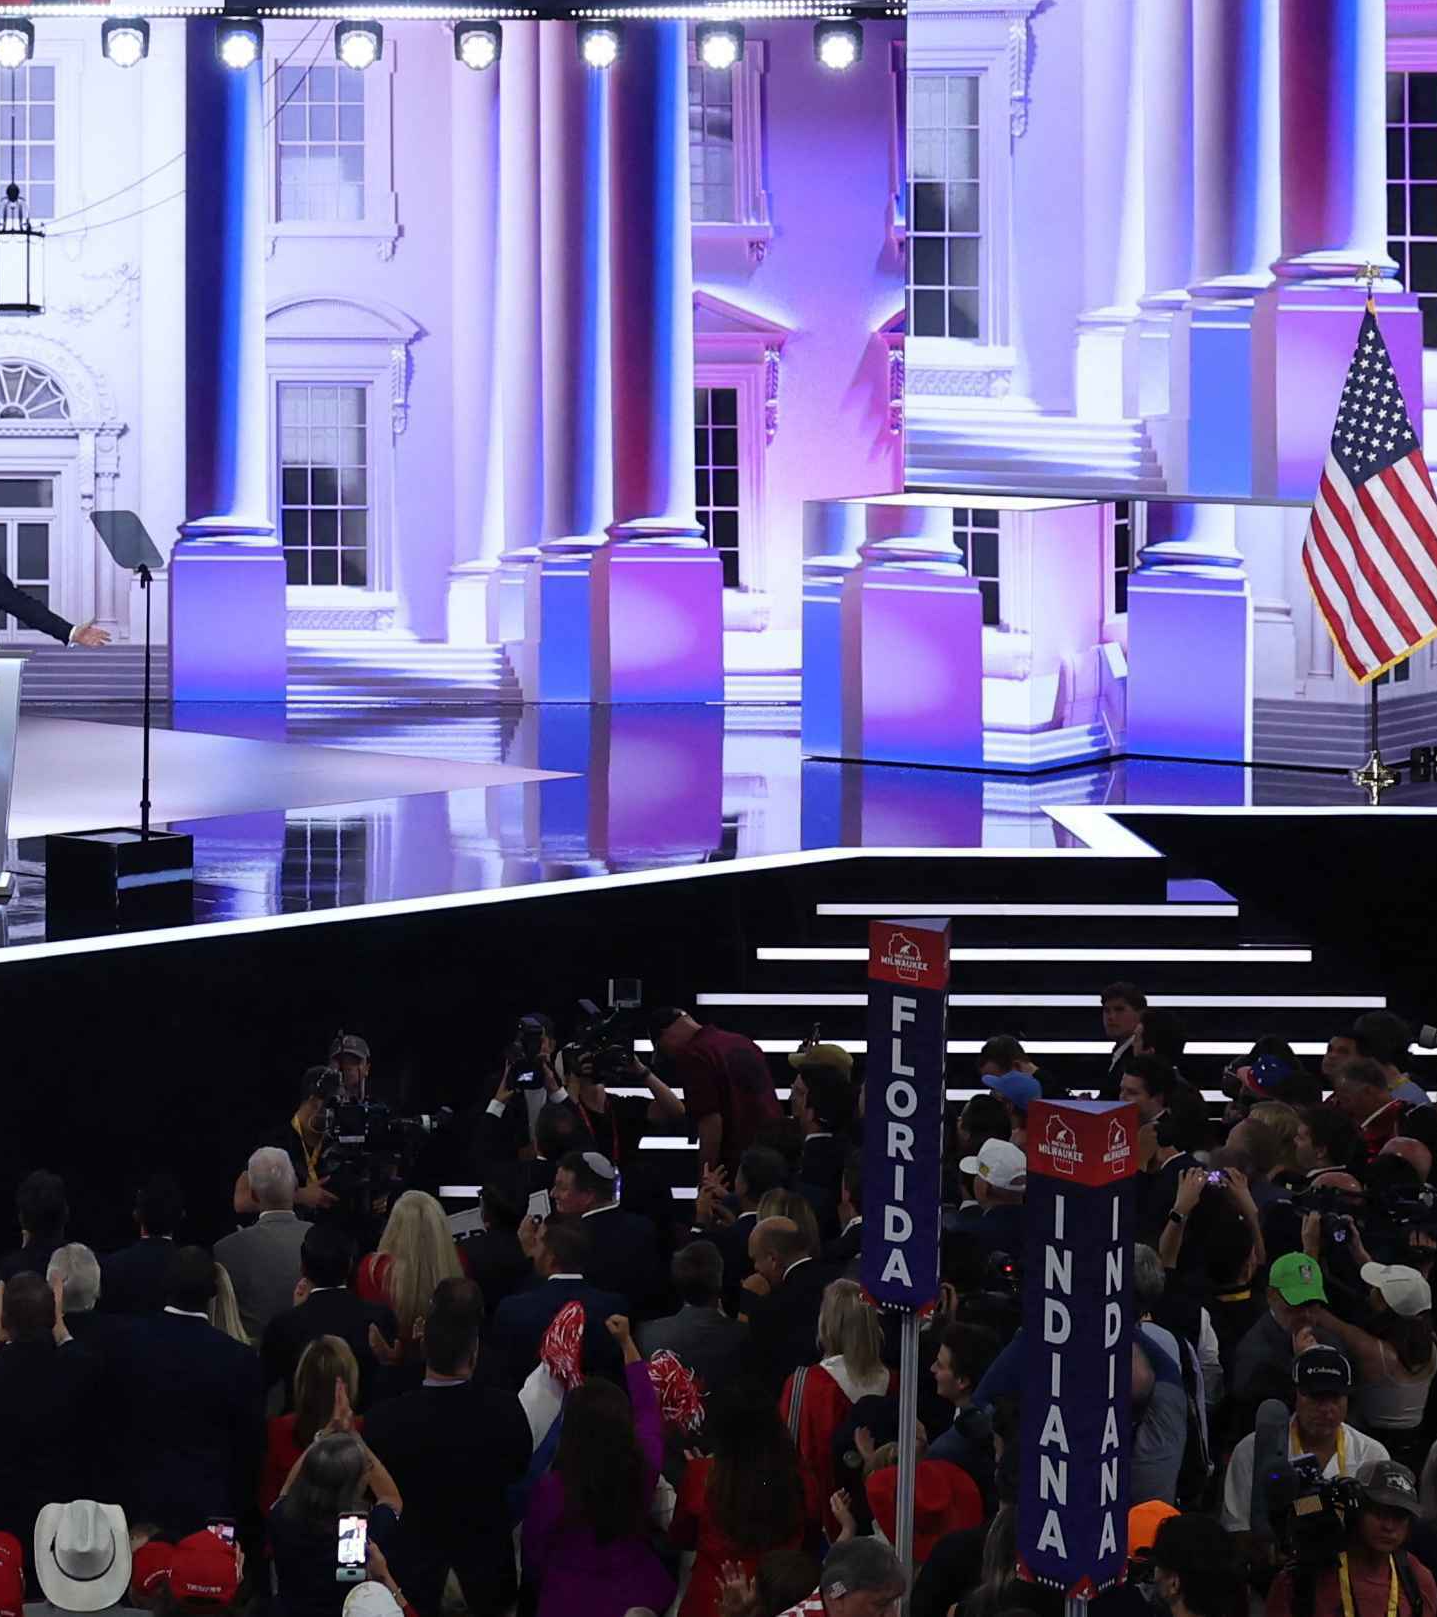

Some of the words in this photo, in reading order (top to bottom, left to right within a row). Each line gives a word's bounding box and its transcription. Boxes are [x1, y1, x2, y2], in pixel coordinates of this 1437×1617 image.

[880, 994, 919, 1289] FLORIDA
[1036, 1194, 1074, 1560] INDIANA
[1098, 1195, 1124, 1561] INDIANA
